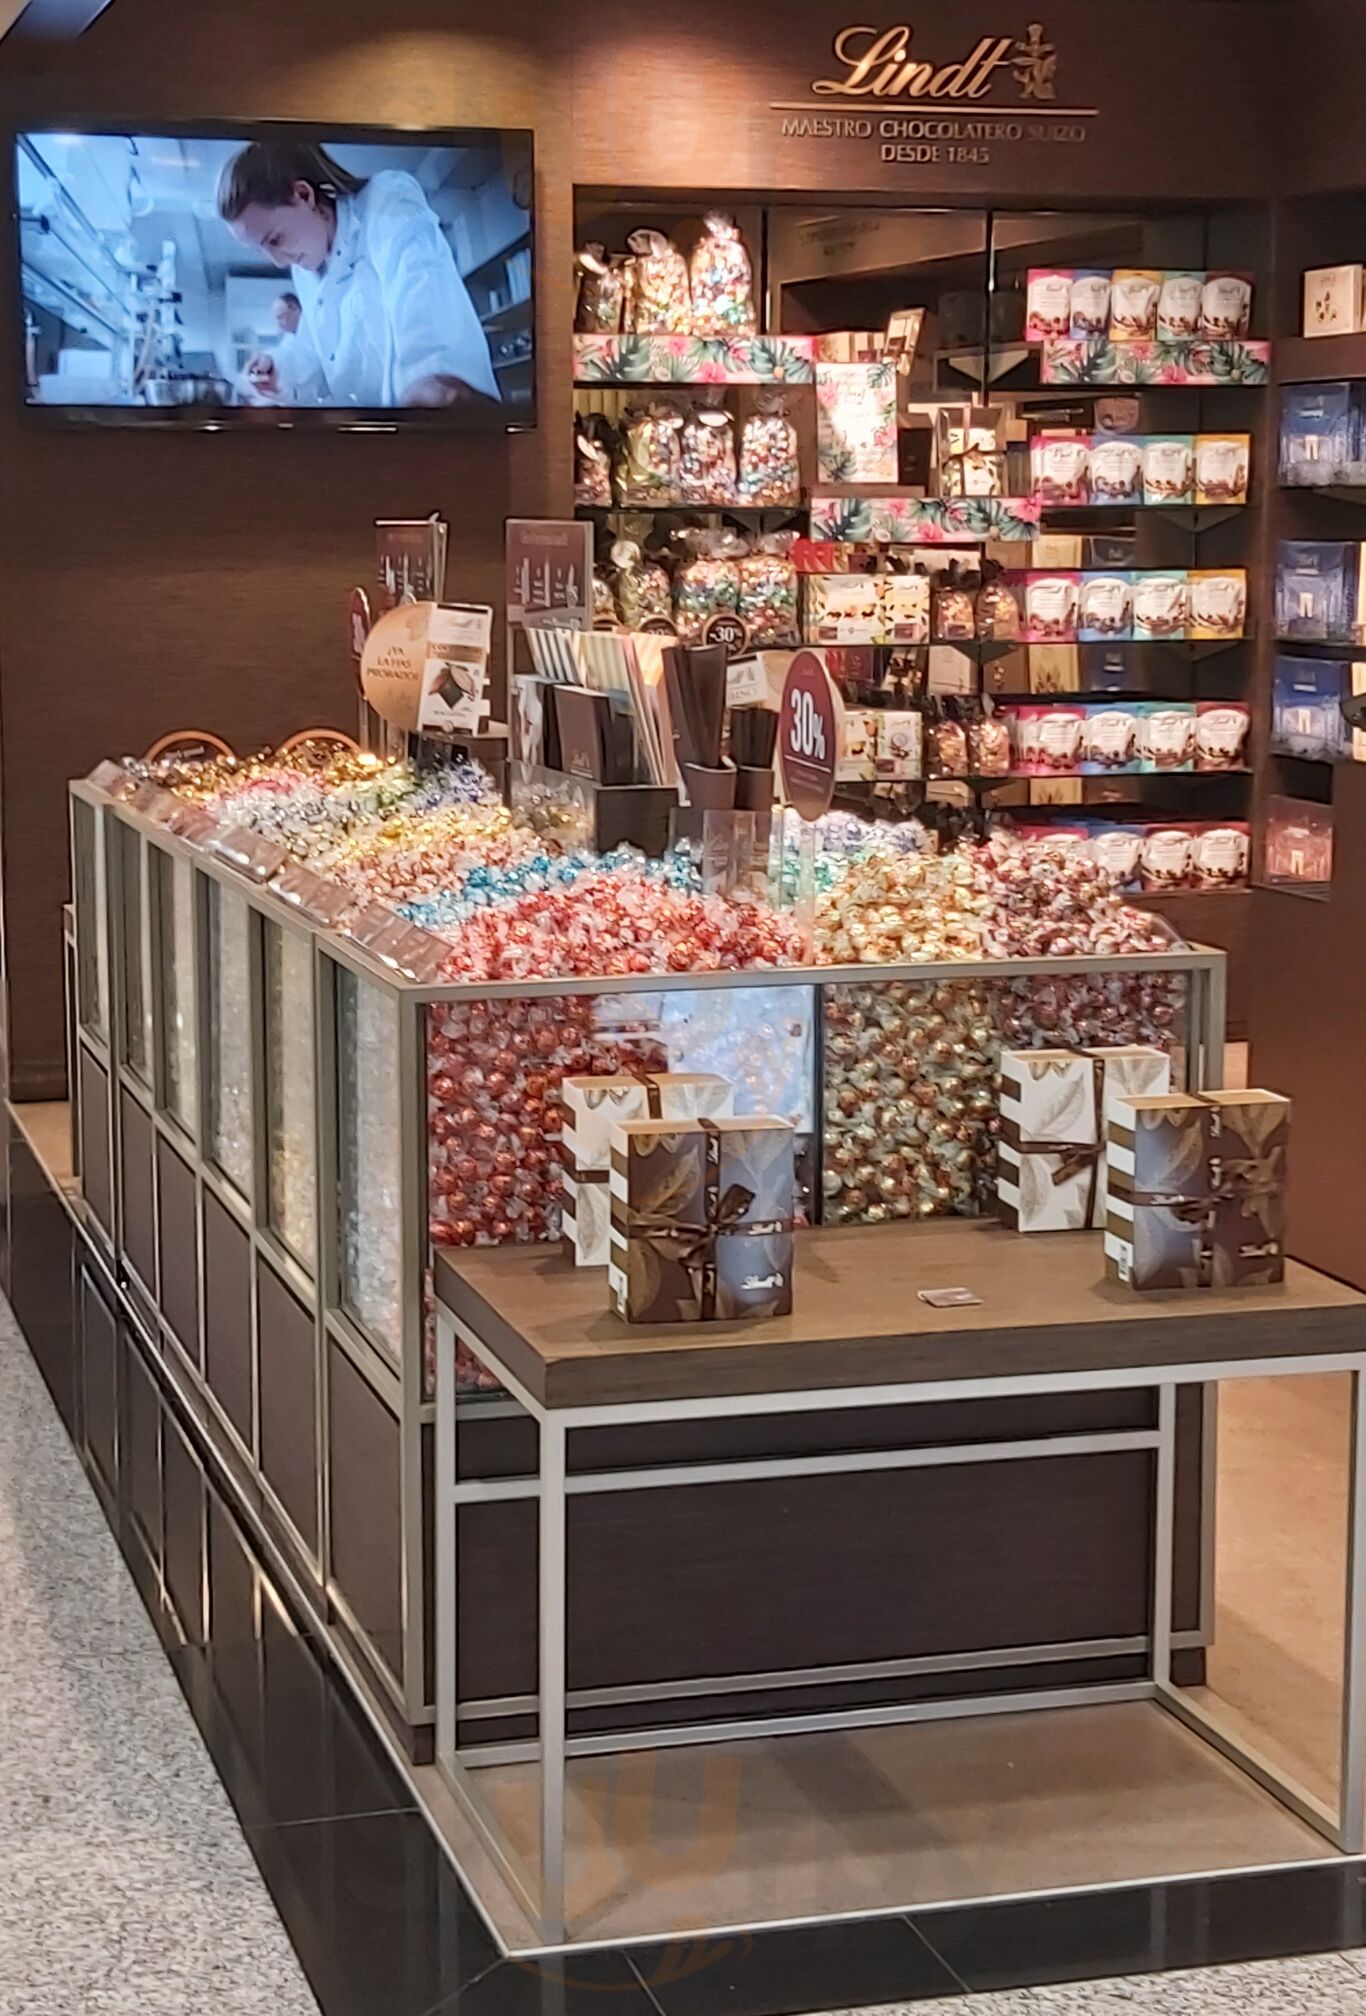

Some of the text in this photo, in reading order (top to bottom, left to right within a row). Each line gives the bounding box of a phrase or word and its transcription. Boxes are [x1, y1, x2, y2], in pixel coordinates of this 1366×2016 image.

[812, 25, 1013, 99] Lindt
[781, 117, 1086, 141] MAESTRO CHOCOLATERO SUIZO
[881, 144, 990, 163] DESDE 1845
[790, 687, 826, 760] 30%
